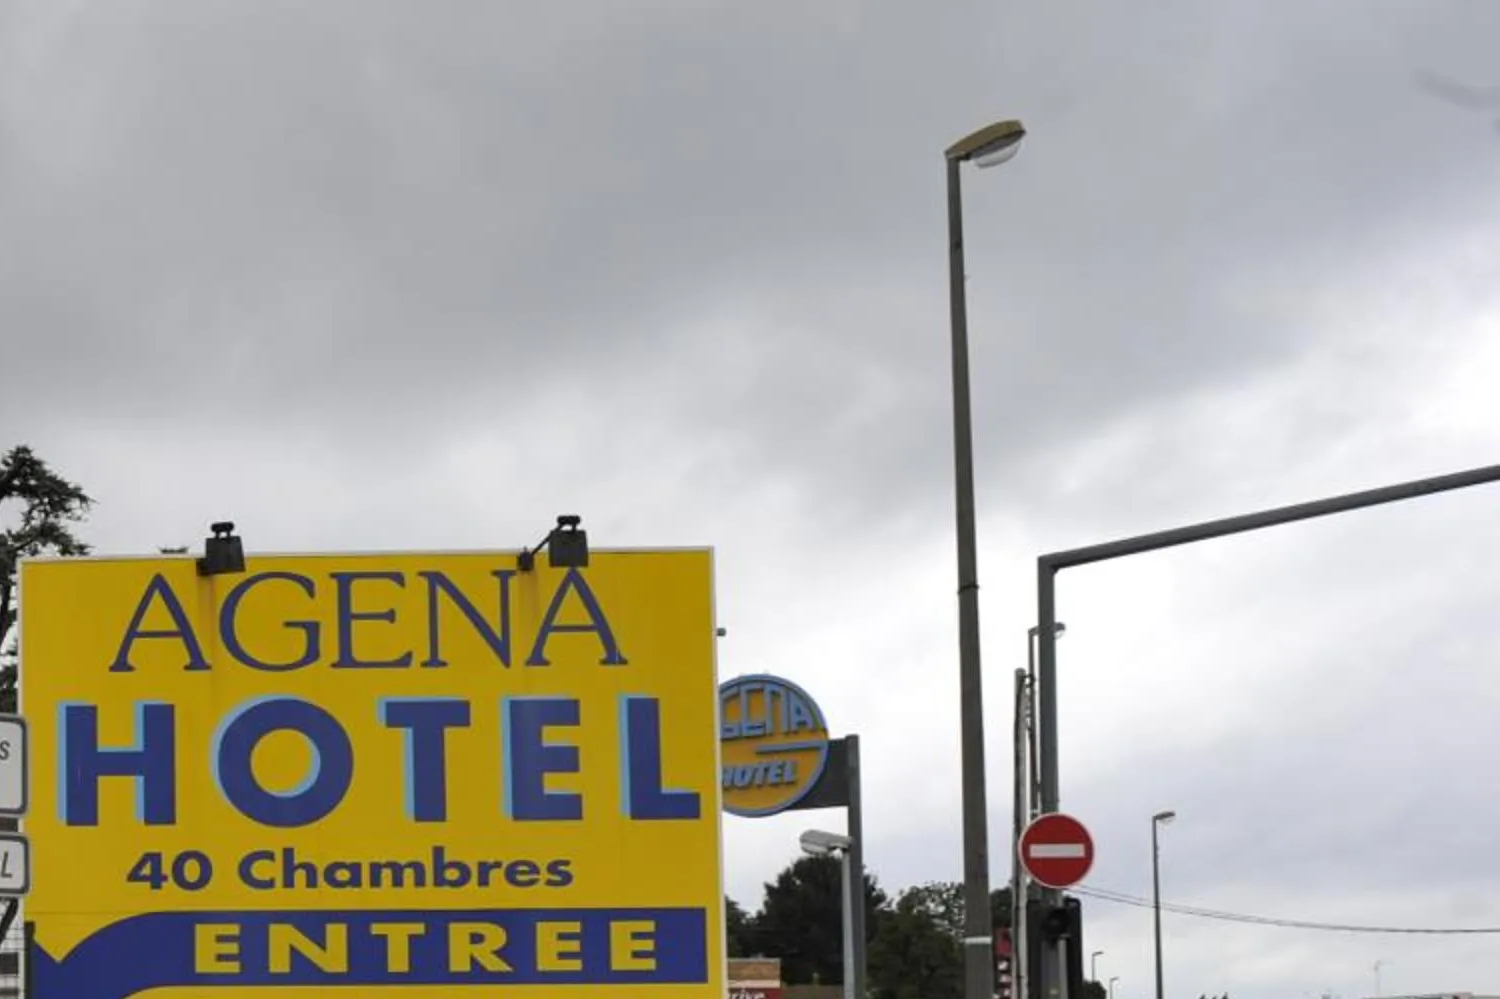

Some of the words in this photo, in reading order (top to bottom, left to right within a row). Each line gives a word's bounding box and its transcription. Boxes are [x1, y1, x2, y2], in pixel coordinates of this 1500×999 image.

[109, 567, 628, 672] AGENA
[56, 694, 701, 828] HOTEL
[722, 760, 798, 790] HOTEL
[127, 851, 213, 890] 40
[237, 847, 575, 890] Chambres
[195, 919, 657, 974] ENTREE
